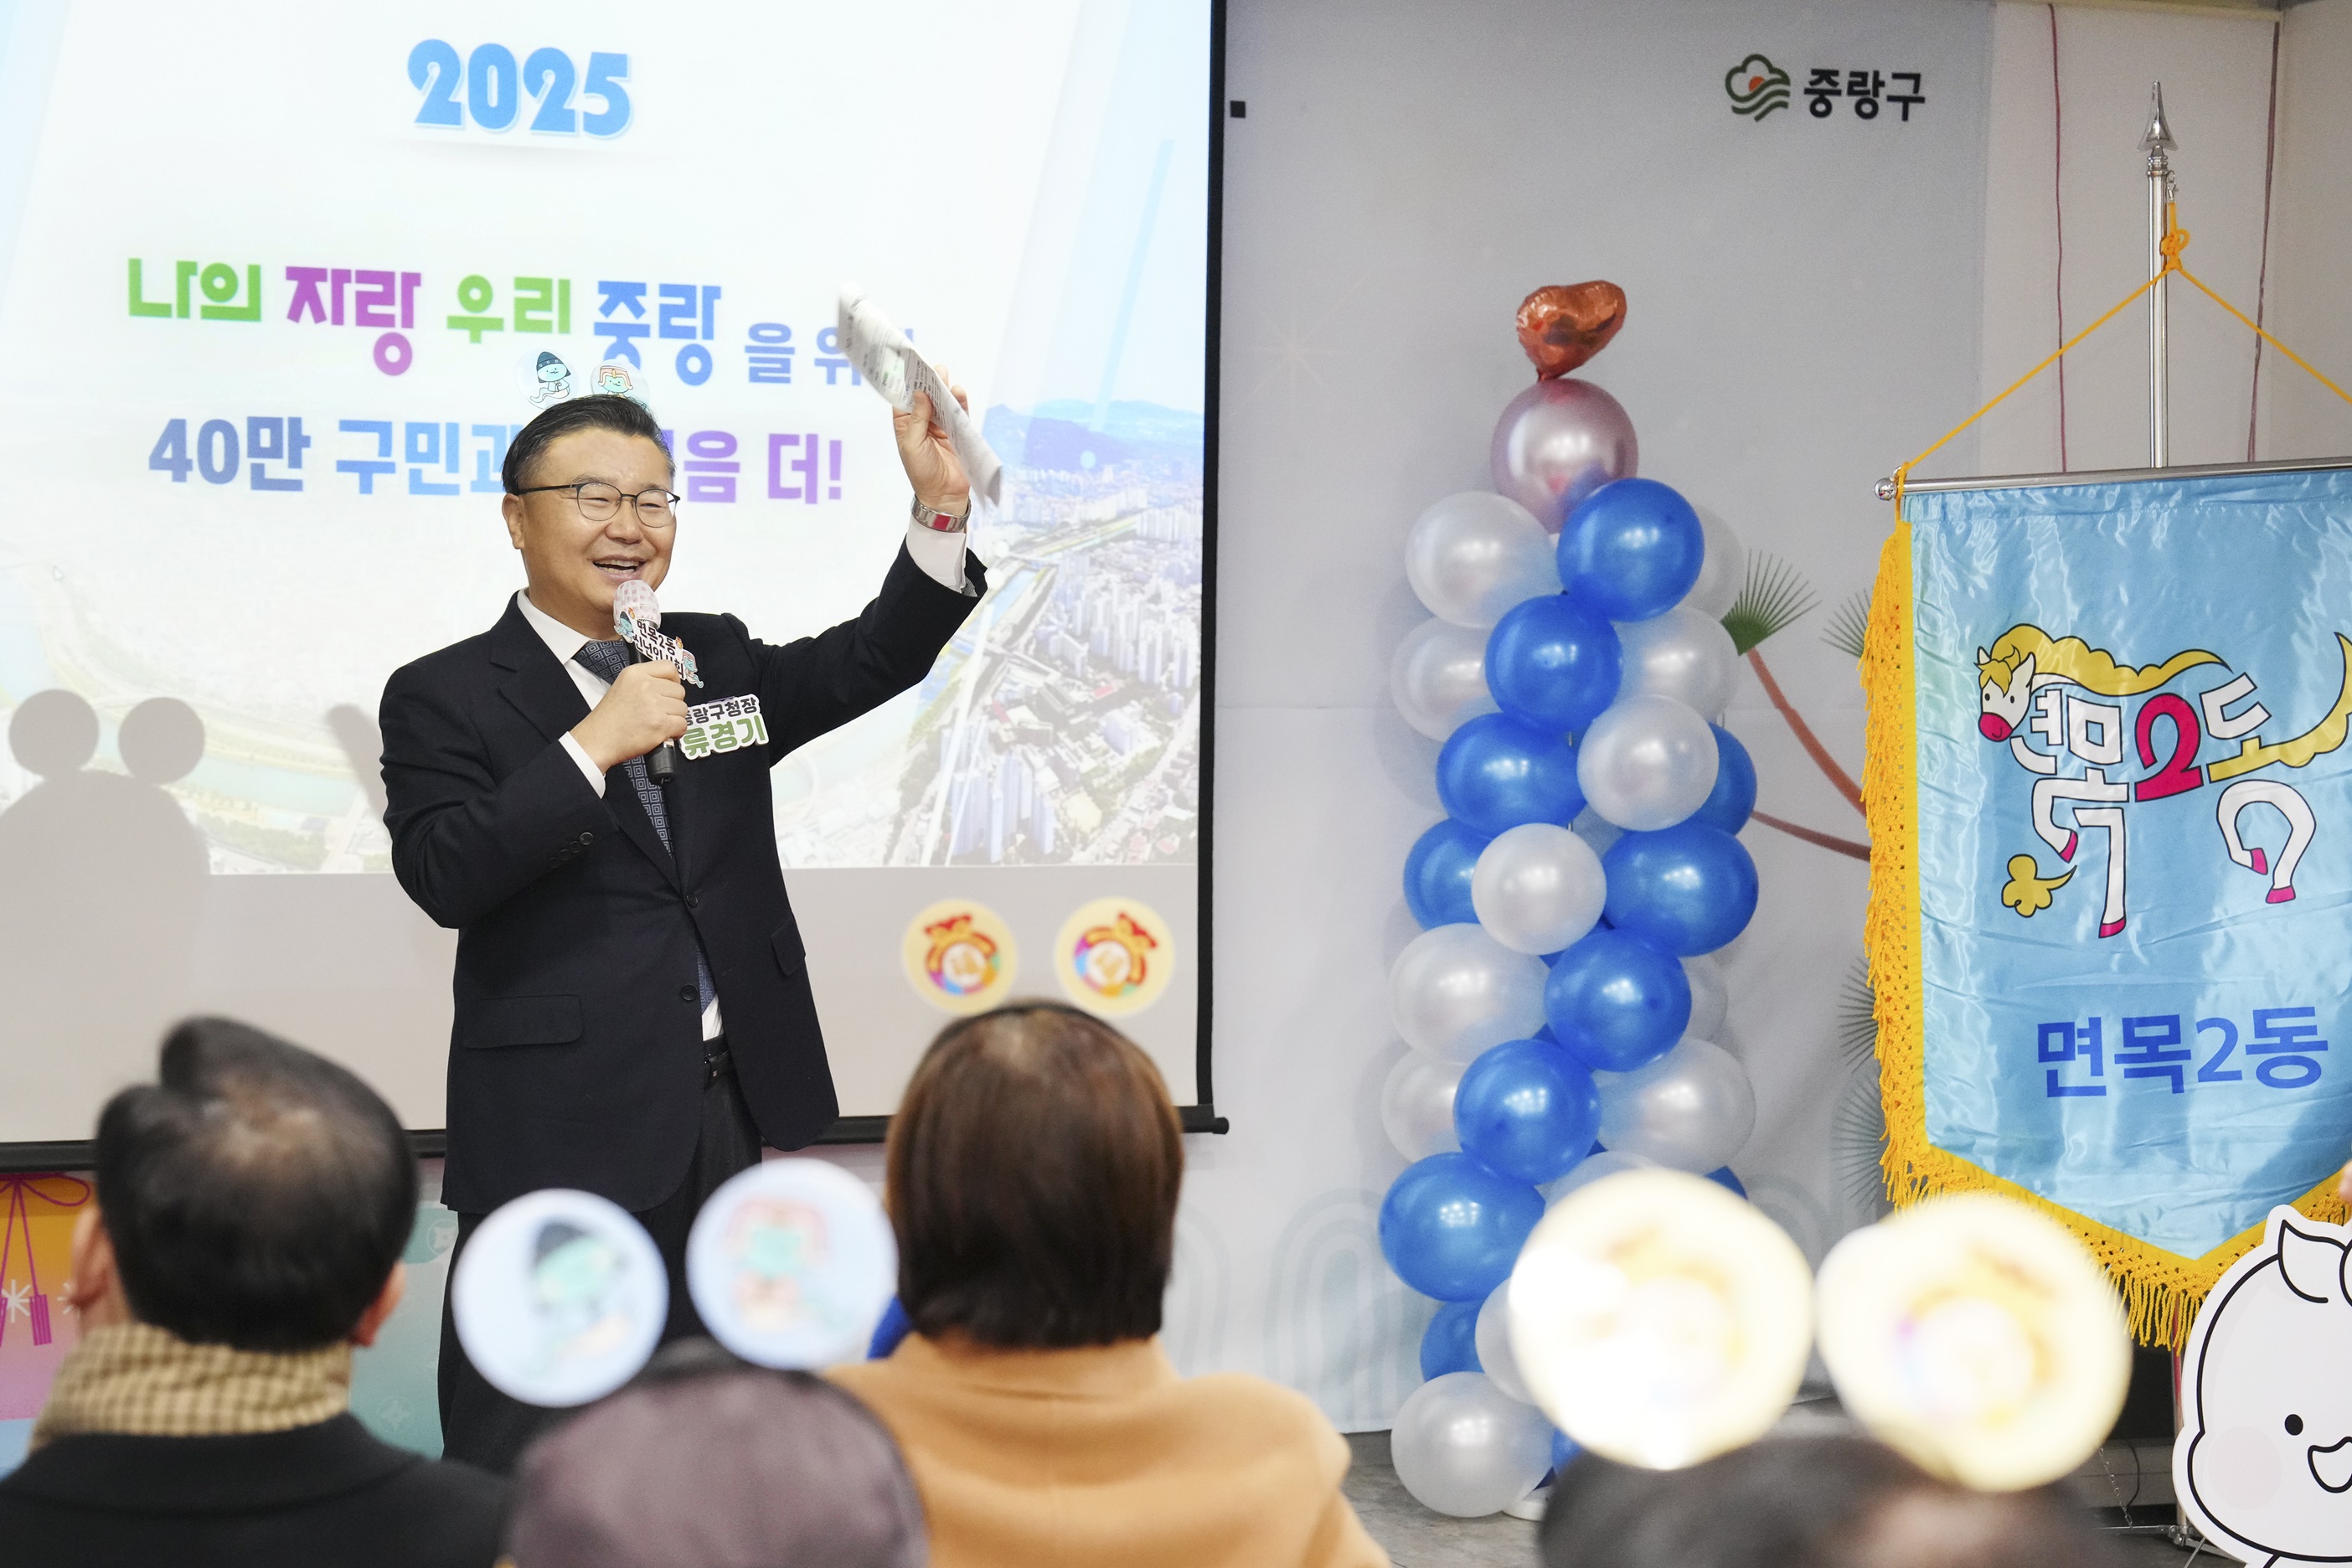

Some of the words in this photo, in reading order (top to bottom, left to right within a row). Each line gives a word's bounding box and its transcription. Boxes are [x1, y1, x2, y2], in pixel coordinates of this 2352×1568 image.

[406, 38, 632, 137] 2025
[1803, 68, 1926, 122] 중랑구
[127, 258, 262, 322] 나의
[285, 266, 421, 376] 자랑
[446, 274, 571, 343] 우리
[593, 280, 722, 387] 중랑
[149, 416, 312, 493] 40만
[660, 429, 740, 503] 음
[767, 434, 842, 504] 더!
[637, 619, 676, 656] 면목2동
[683, 714, 766, 756] 류경기
[2037, 1006, 2329, 1098] 면목2동
